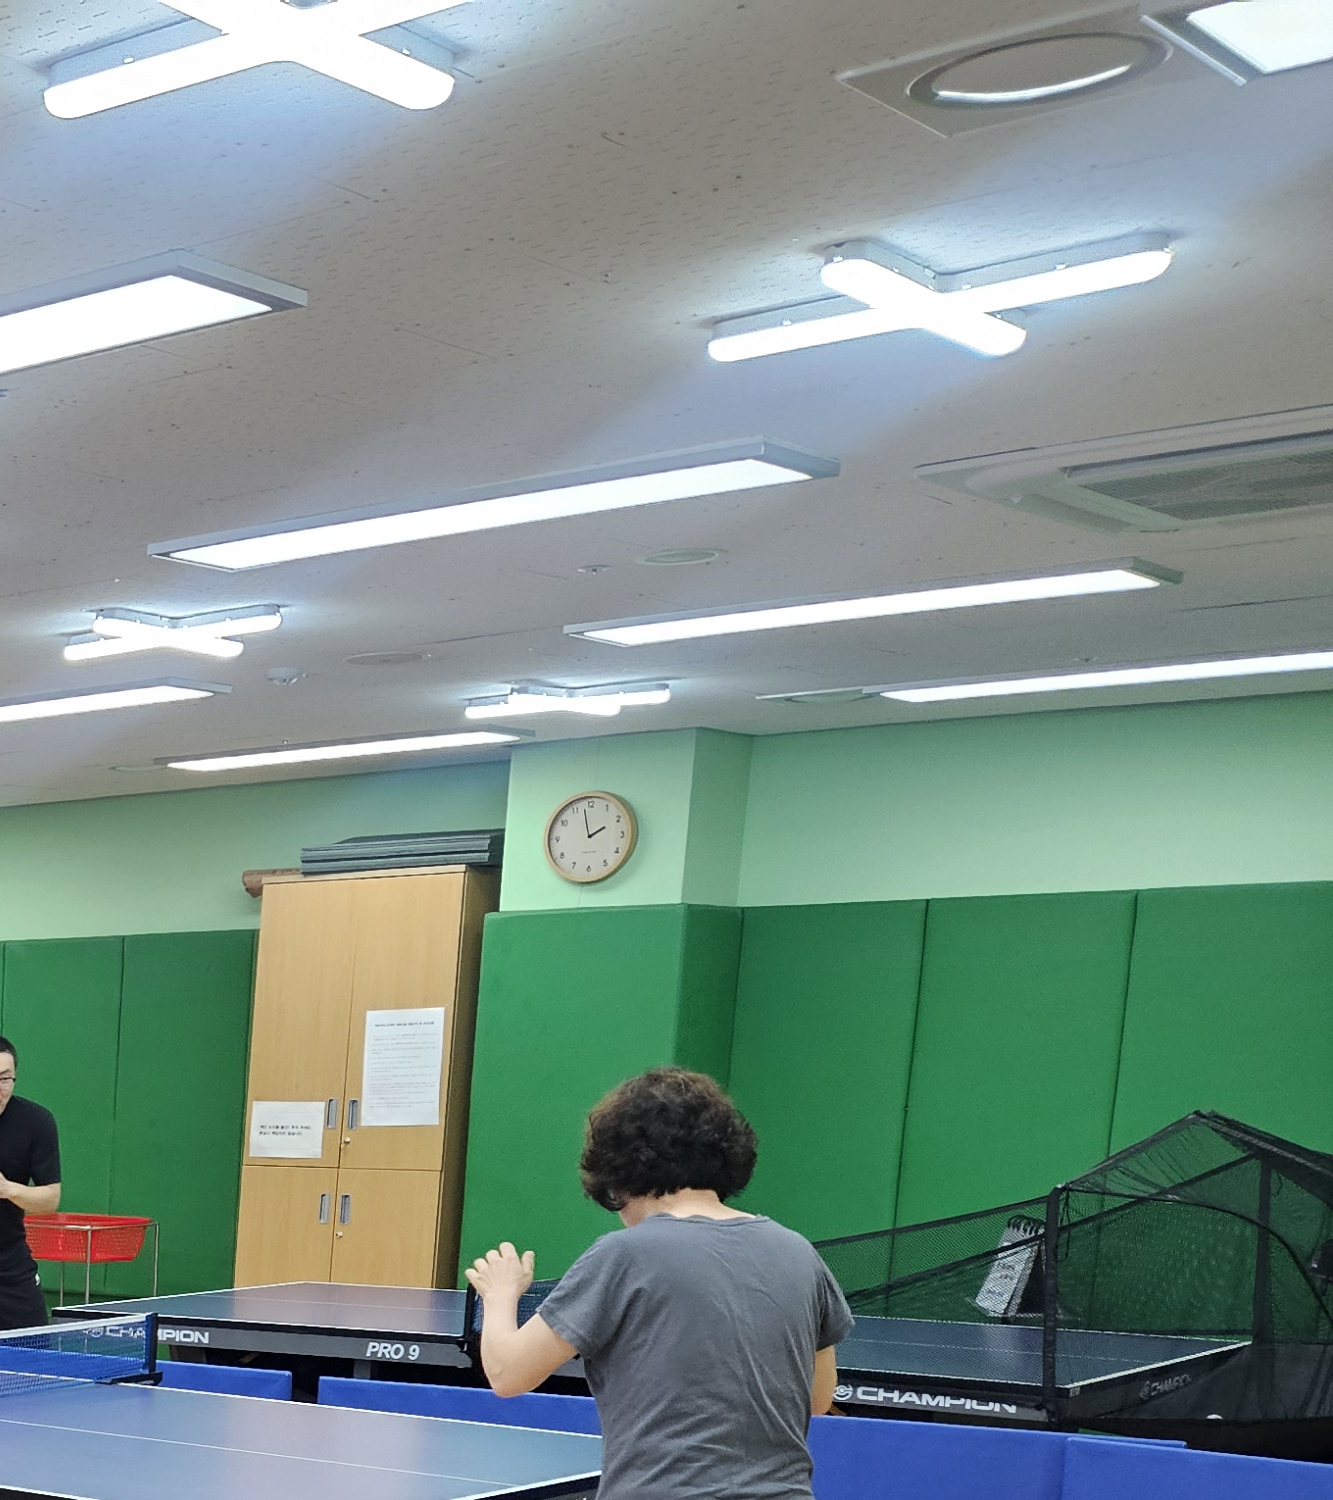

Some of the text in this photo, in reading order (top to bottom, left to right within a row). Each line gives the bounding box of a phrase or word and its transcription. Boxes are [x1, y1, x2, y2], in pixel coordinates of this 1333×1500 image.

[587, 800, 595, 809] 12
[561, 819, 568, 827] 10
[616, 815, 621, 823] 2
[620, 831, 625, 839] 3
[560, 851, 565, 859] 8
[586, 865, 592, 873] 6
[366, 1341, 420, 1361] PRO 9
